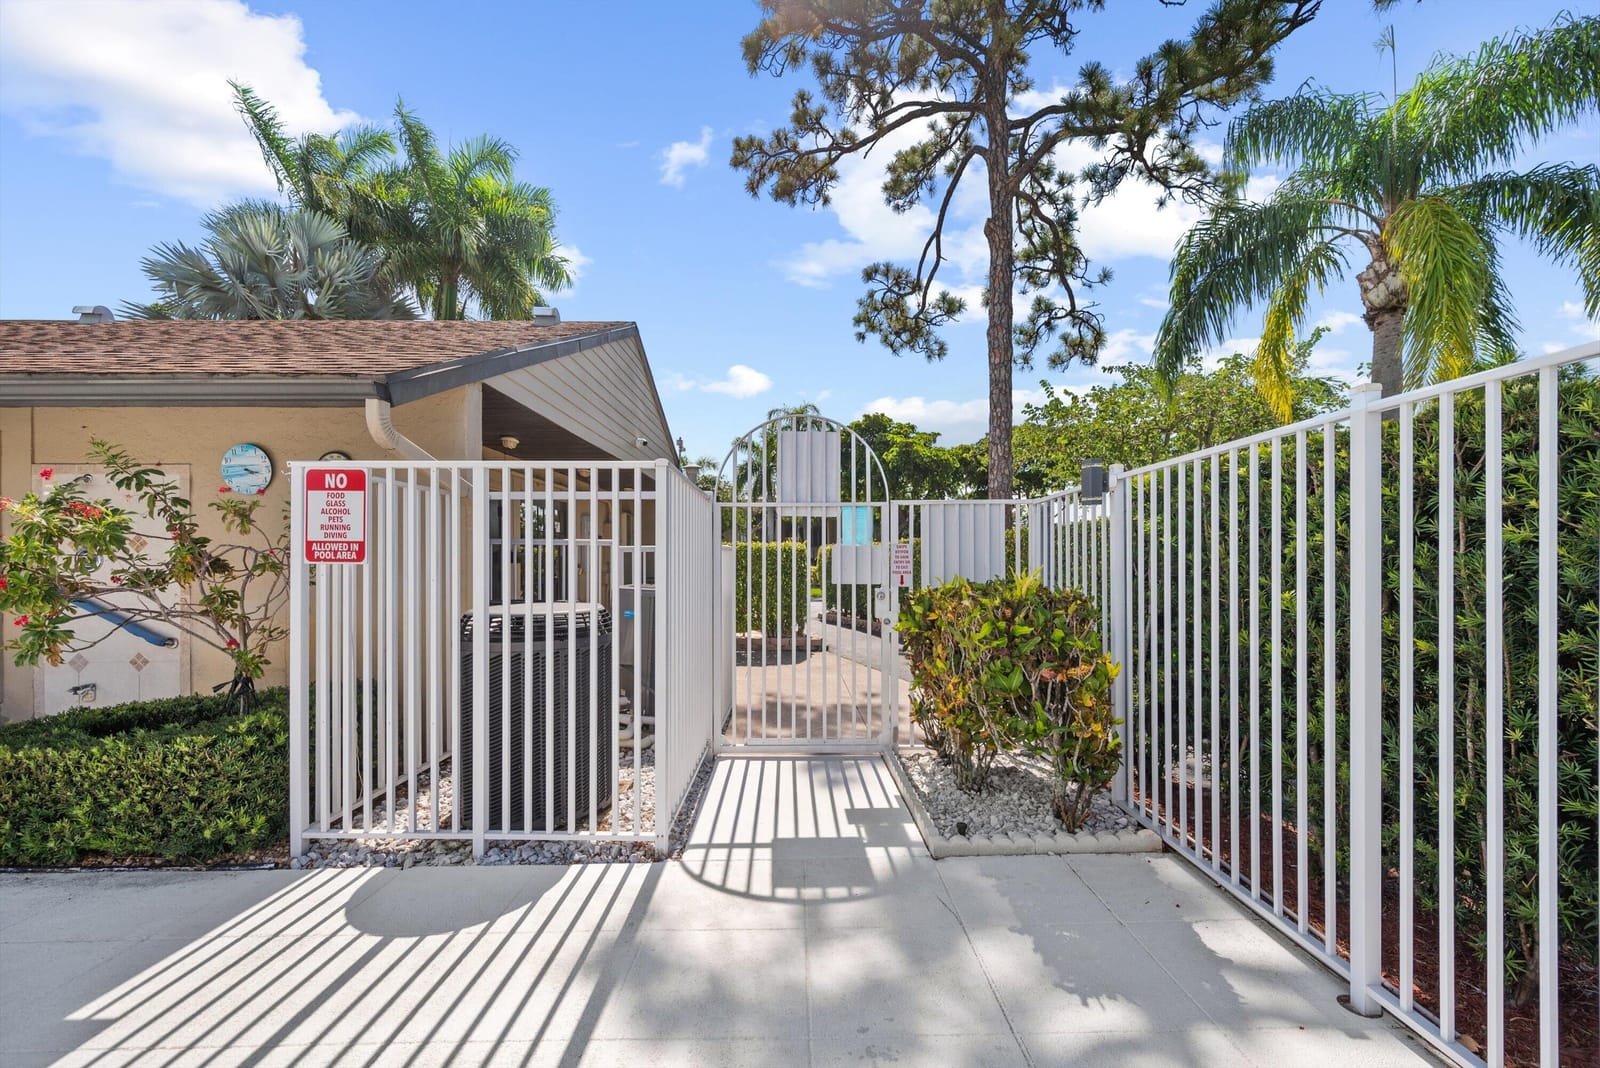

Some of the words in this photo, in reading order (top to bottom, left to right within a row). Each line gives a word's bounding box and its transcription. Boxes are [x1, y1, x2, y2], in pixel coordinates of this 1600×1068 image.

[325, 473, 348, 489] NO
[311, 542, 348, 551] ALLOWED
[350, 542, 358, 551] IN
[314, 552, 336, 560] POOL
[336, 552, 357, 560] AREA
